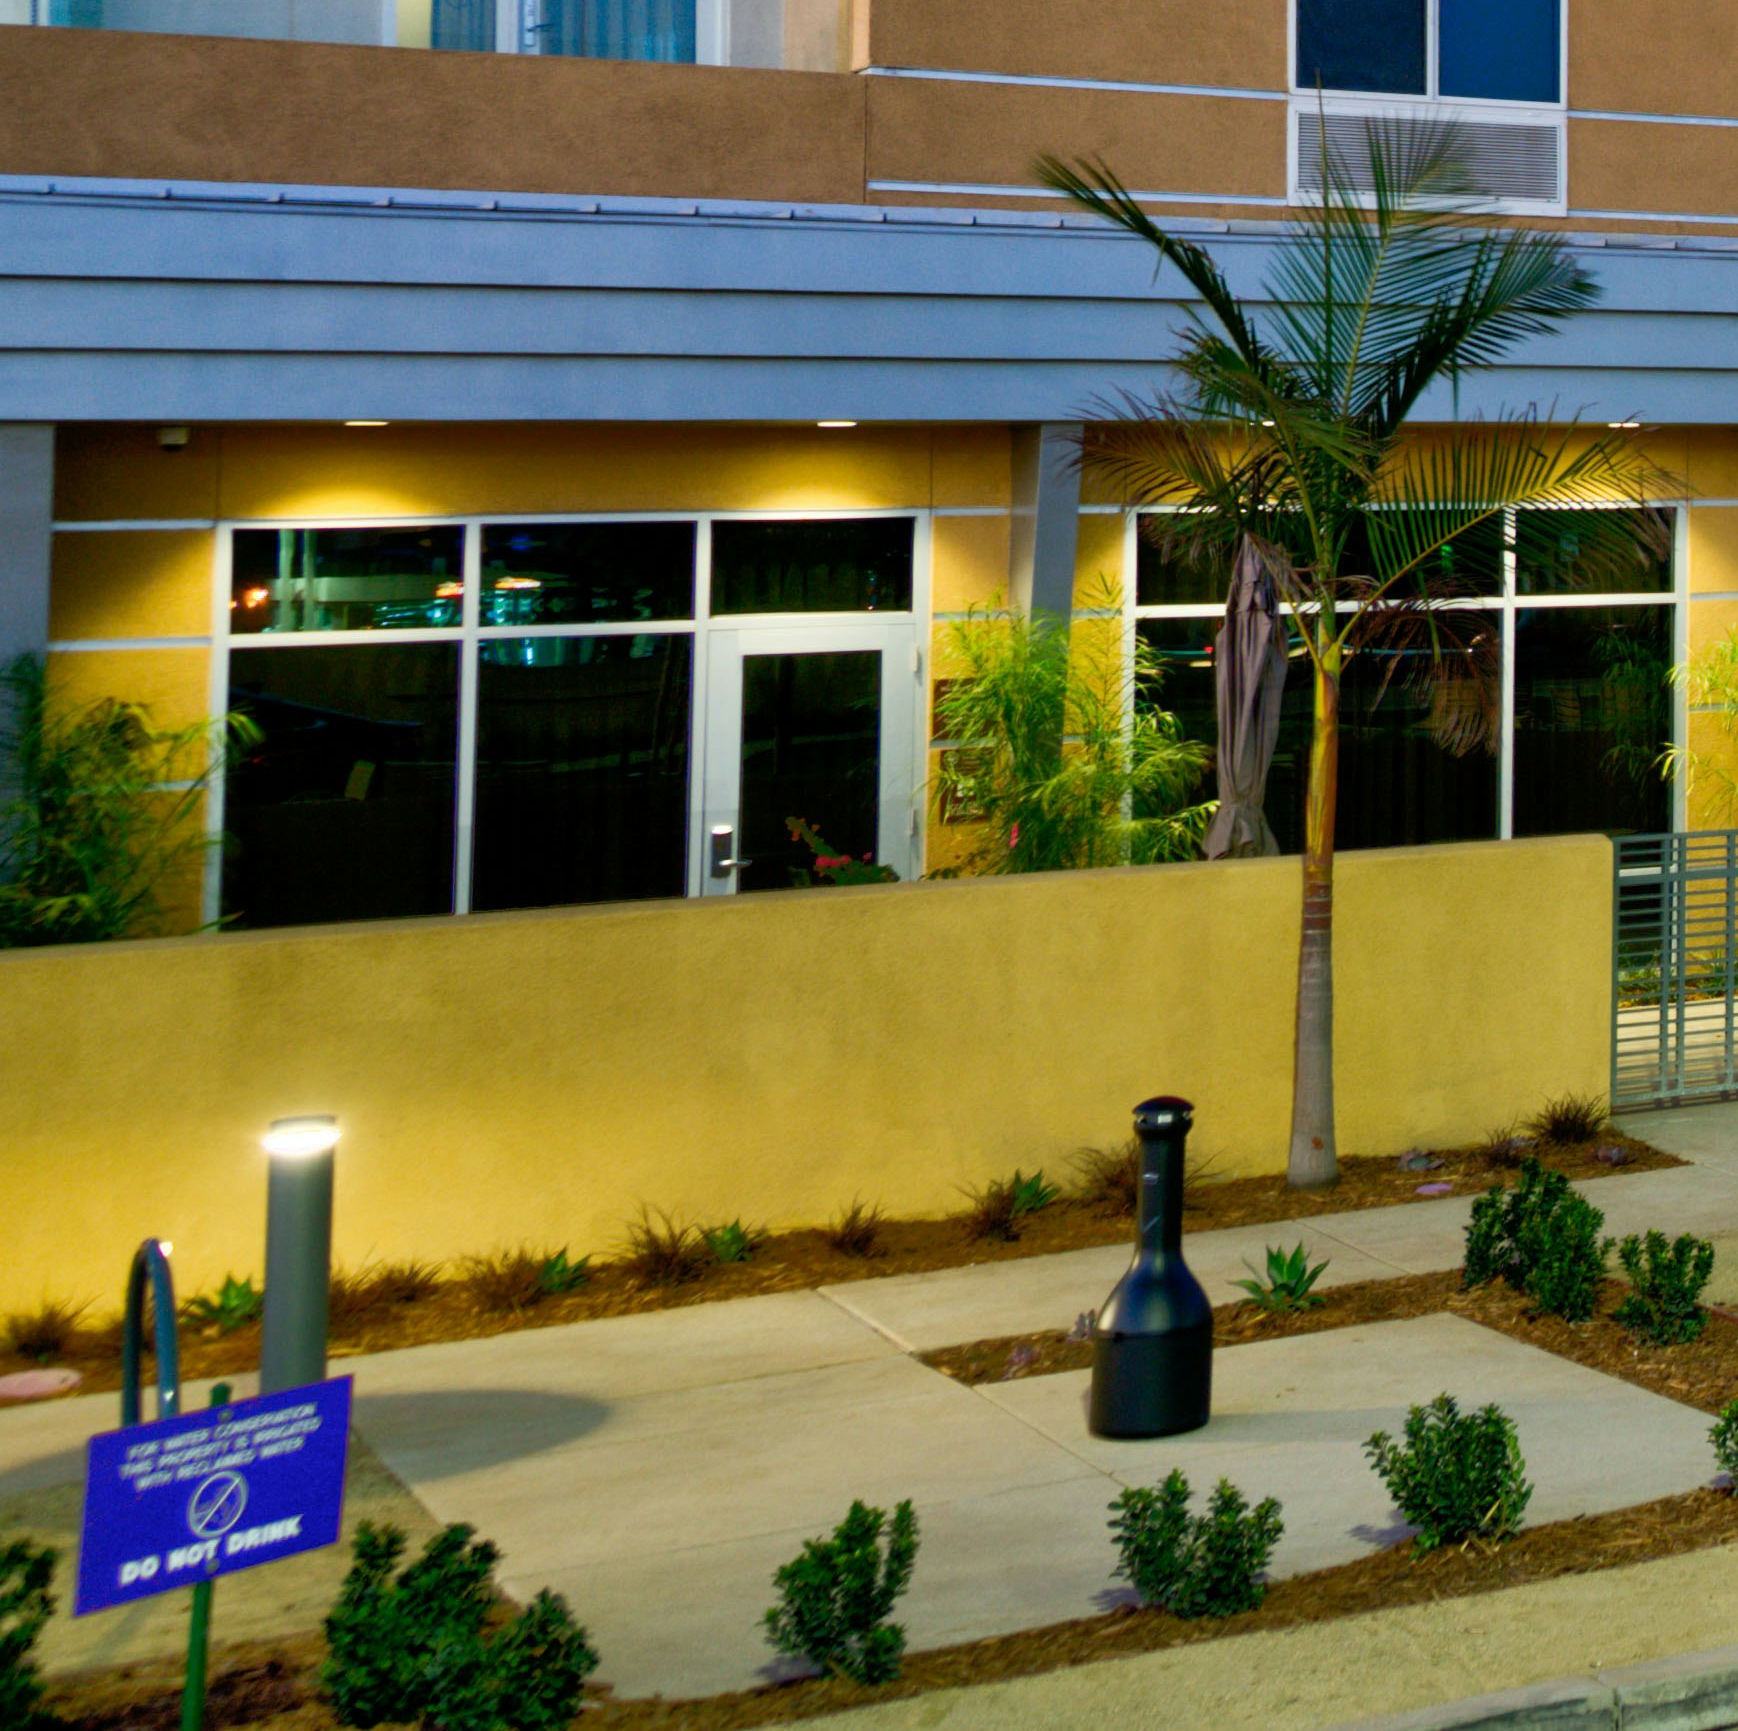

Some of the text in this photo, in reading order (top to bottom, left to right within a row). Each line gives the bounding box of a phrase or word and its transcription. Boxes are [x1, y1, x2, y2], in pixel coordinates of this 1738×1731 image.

[119, 1417, 322, 1479] THIS PROPERTY IS IRRIGATED
[128, 1403, 317, 1459] FOR WATER CONSERVATION
[135, 1436, 304, 1491] WITH RECLAIMED WATER
[120, 1515, 303, 1586] DO NOT DRINK
